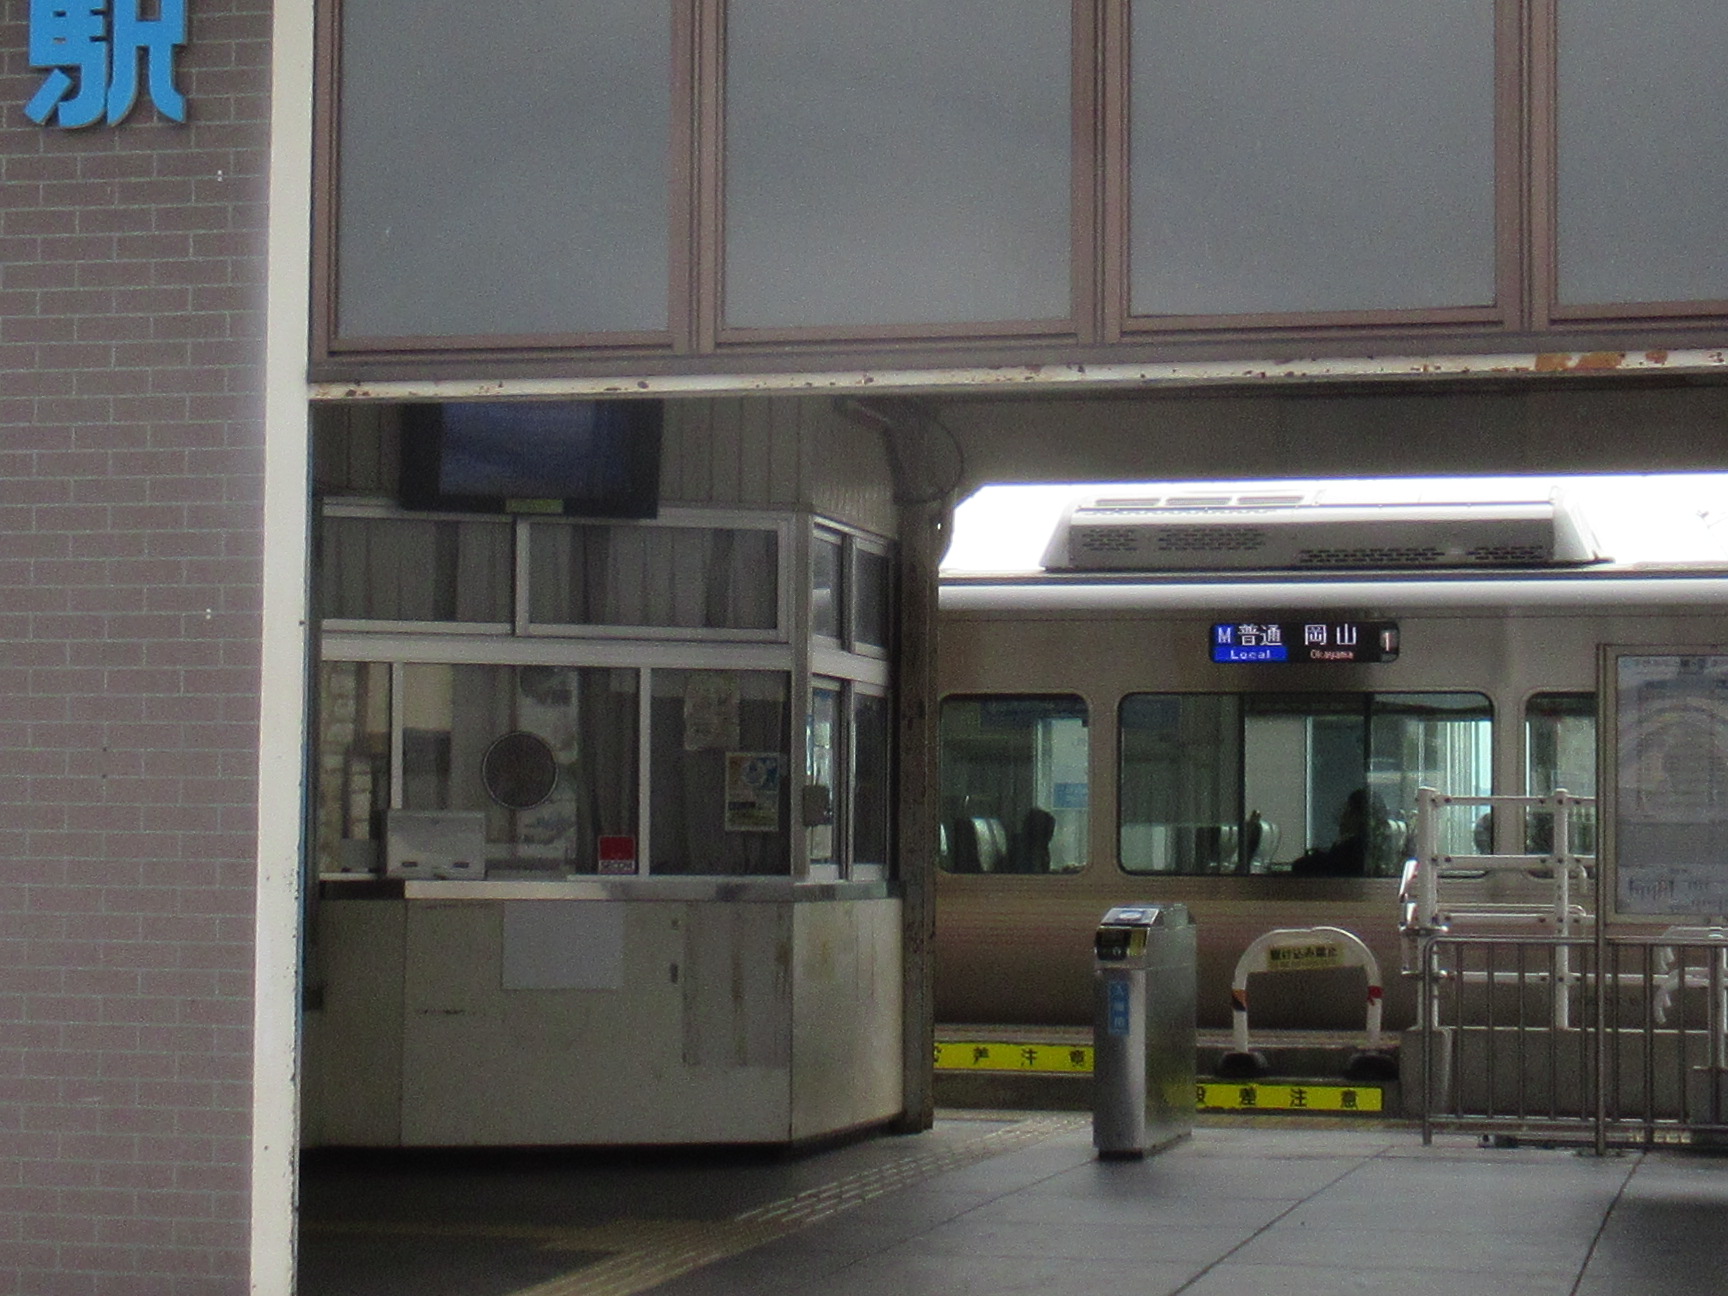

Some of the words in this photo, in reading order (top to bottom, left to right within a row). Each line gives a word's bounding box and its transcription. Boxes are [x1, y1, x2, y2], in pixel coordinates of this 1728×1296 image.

[1237, 623, 1282, 646] 普通
[1304, 623, 1357, 646] 岡山
[1230, 649, 1271, 660] Local
[1310, 649, 1354, 660] Okayama
